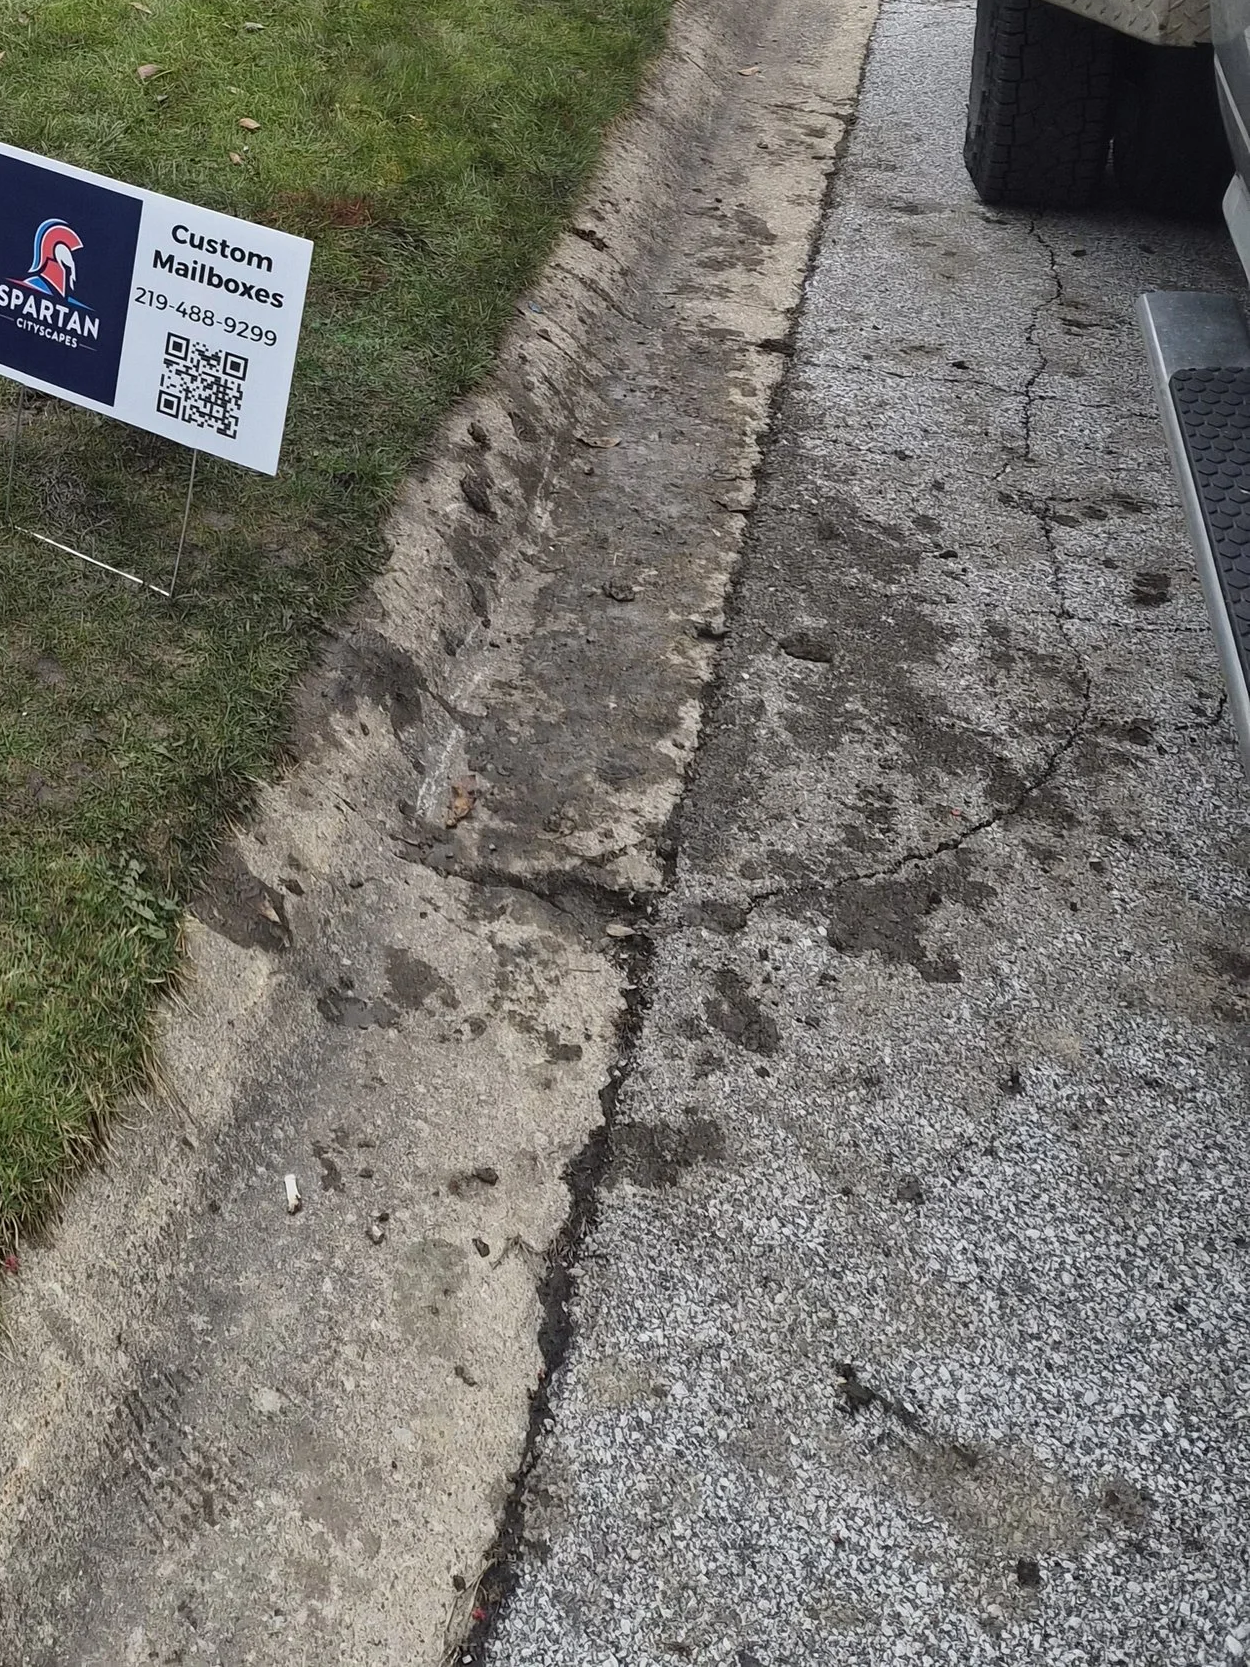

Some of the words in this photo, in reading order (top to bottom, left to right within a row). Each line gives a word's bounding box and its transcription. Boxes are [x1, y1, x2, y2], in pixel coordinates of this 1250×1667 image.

[171, 224, 274, 274] Custom
[152, 249, 285, 309] Mailboxes
[16, 317, 79, 349] CITYSCAPES
[134, 286, 278, 347] 219-488-9299
